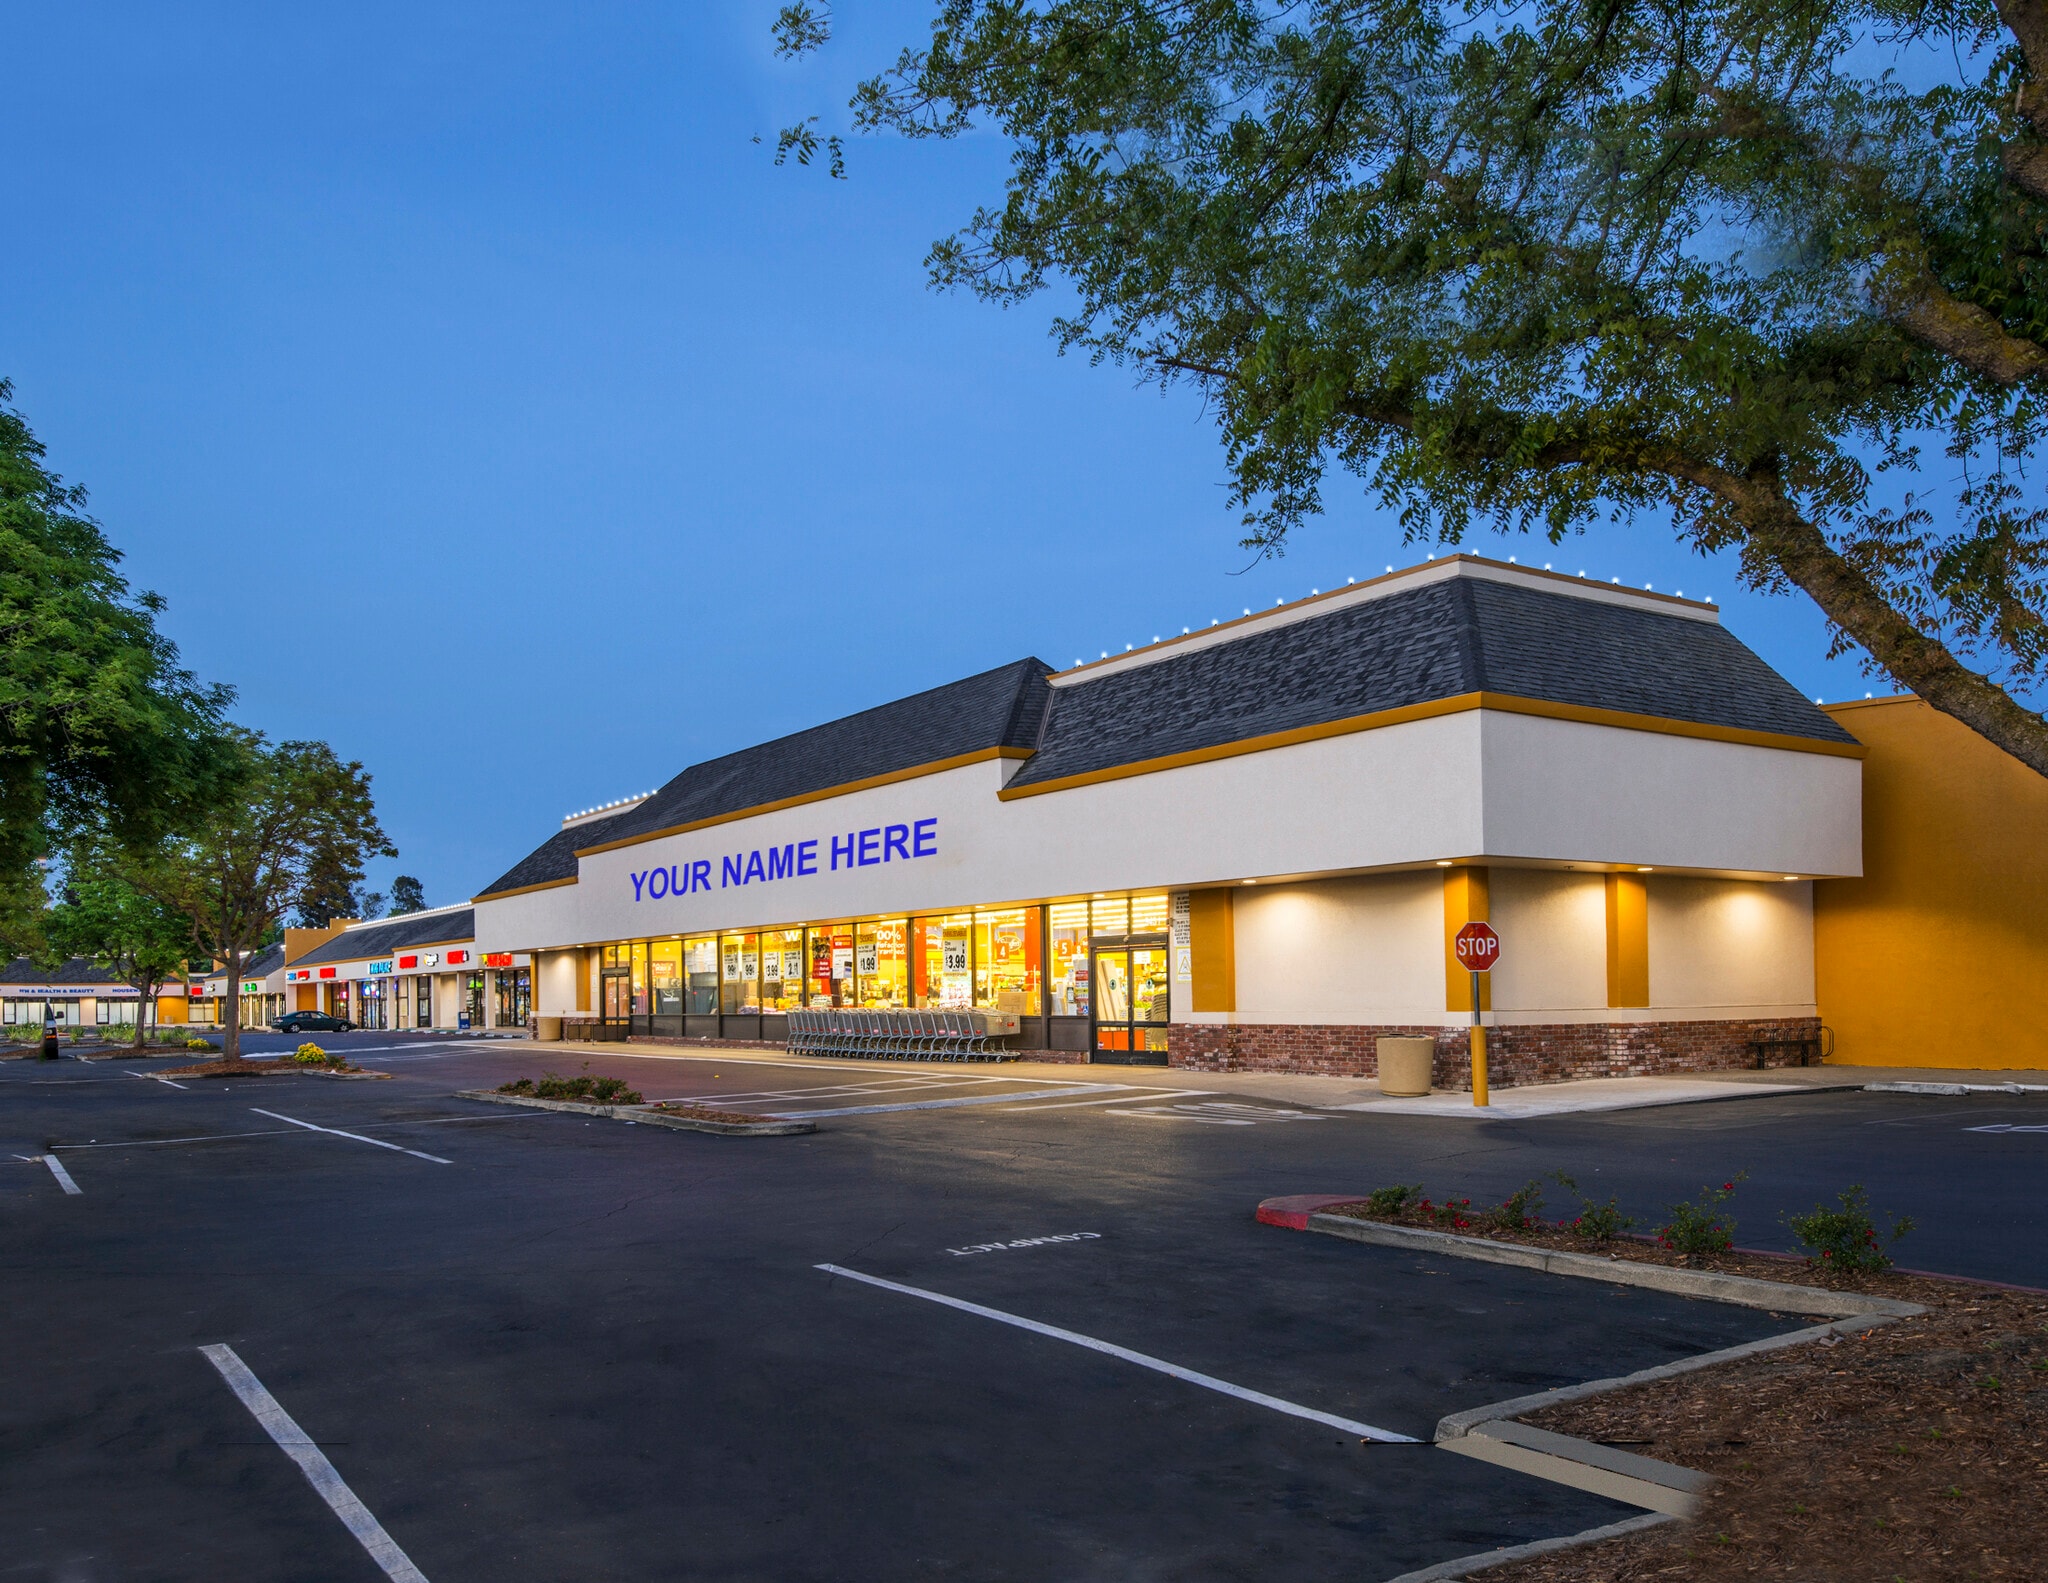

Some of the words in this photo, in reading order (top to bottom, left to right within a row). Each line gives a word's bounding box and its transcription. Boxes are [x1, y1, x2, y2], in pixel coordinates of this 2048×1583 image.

[630, 860, 712, 902] YOUR
[721, 839, 818, 888] NAME
[830, 817, 938, 871] HERE
[1000, 945, 1006, 958] 4
[1061, 942, 1068, 955] 5
[1457, 937, 1497, 956] STOP
[945, 1232, 1102, 1256] COMPACT
